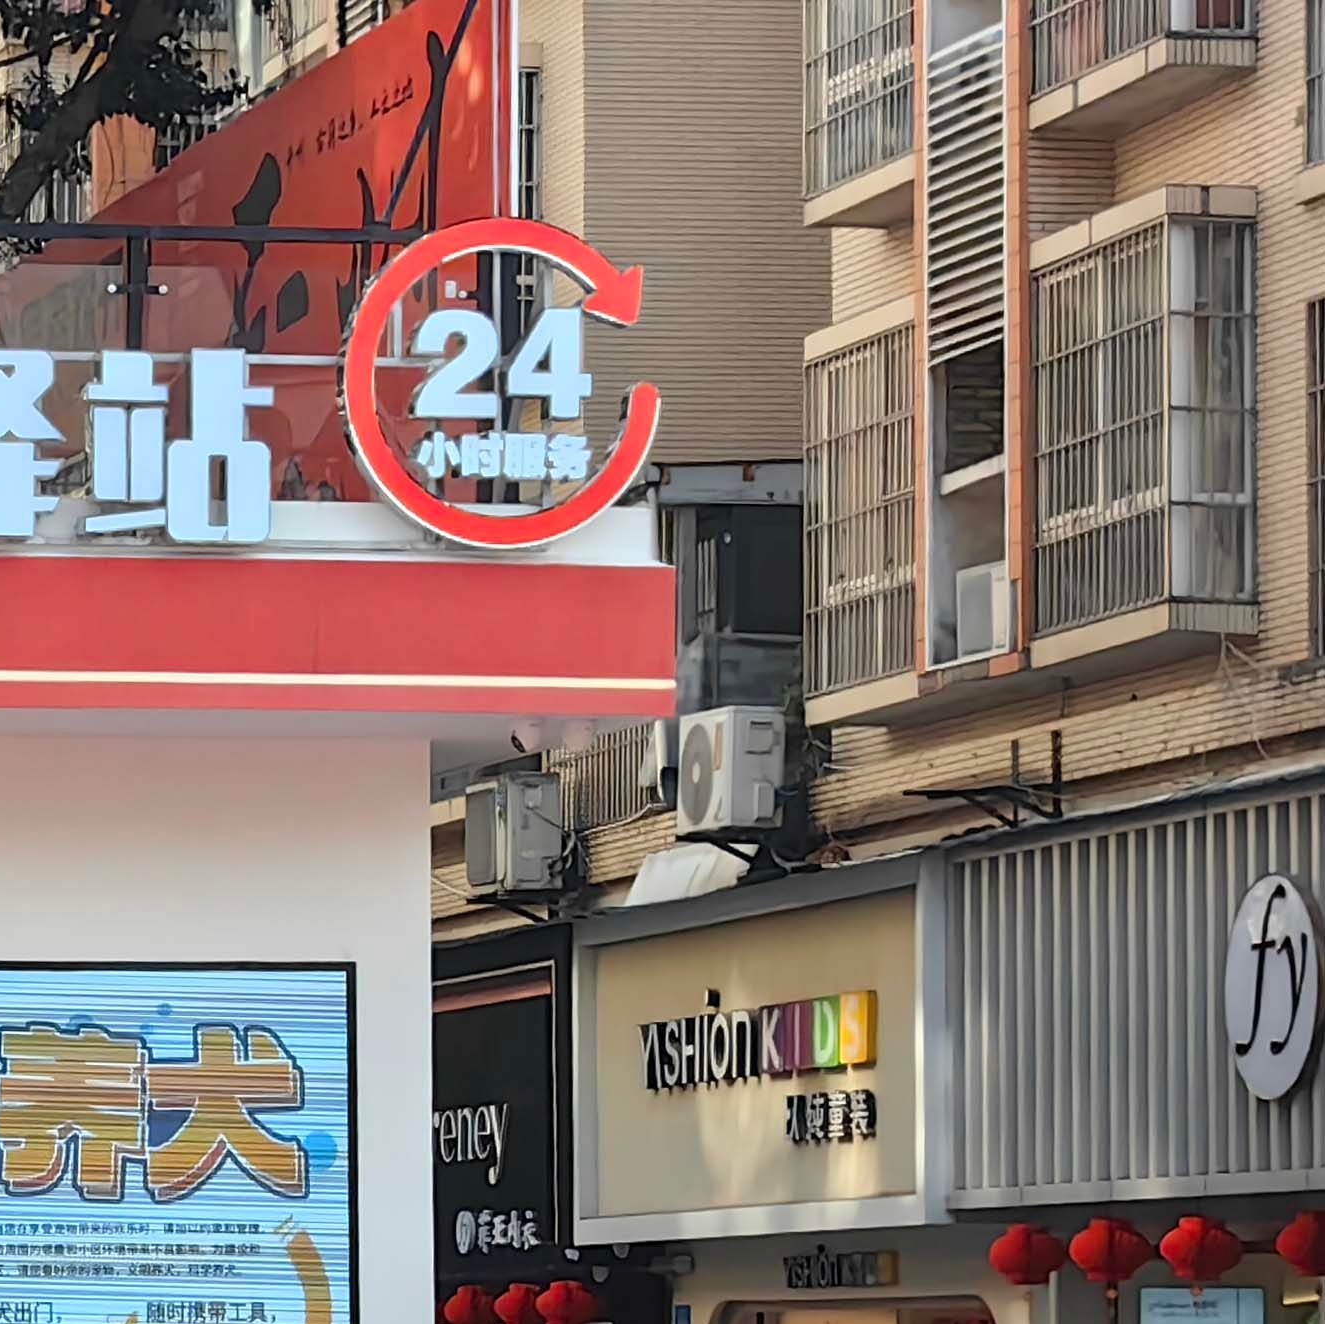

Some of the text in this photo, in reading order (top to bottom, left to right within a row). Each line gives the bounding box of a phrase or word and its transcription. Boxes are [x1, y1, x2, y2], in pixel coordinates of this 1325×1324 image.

[412, 307, 593, 419] 24
[417, 431, 591, 480] 小时服务
